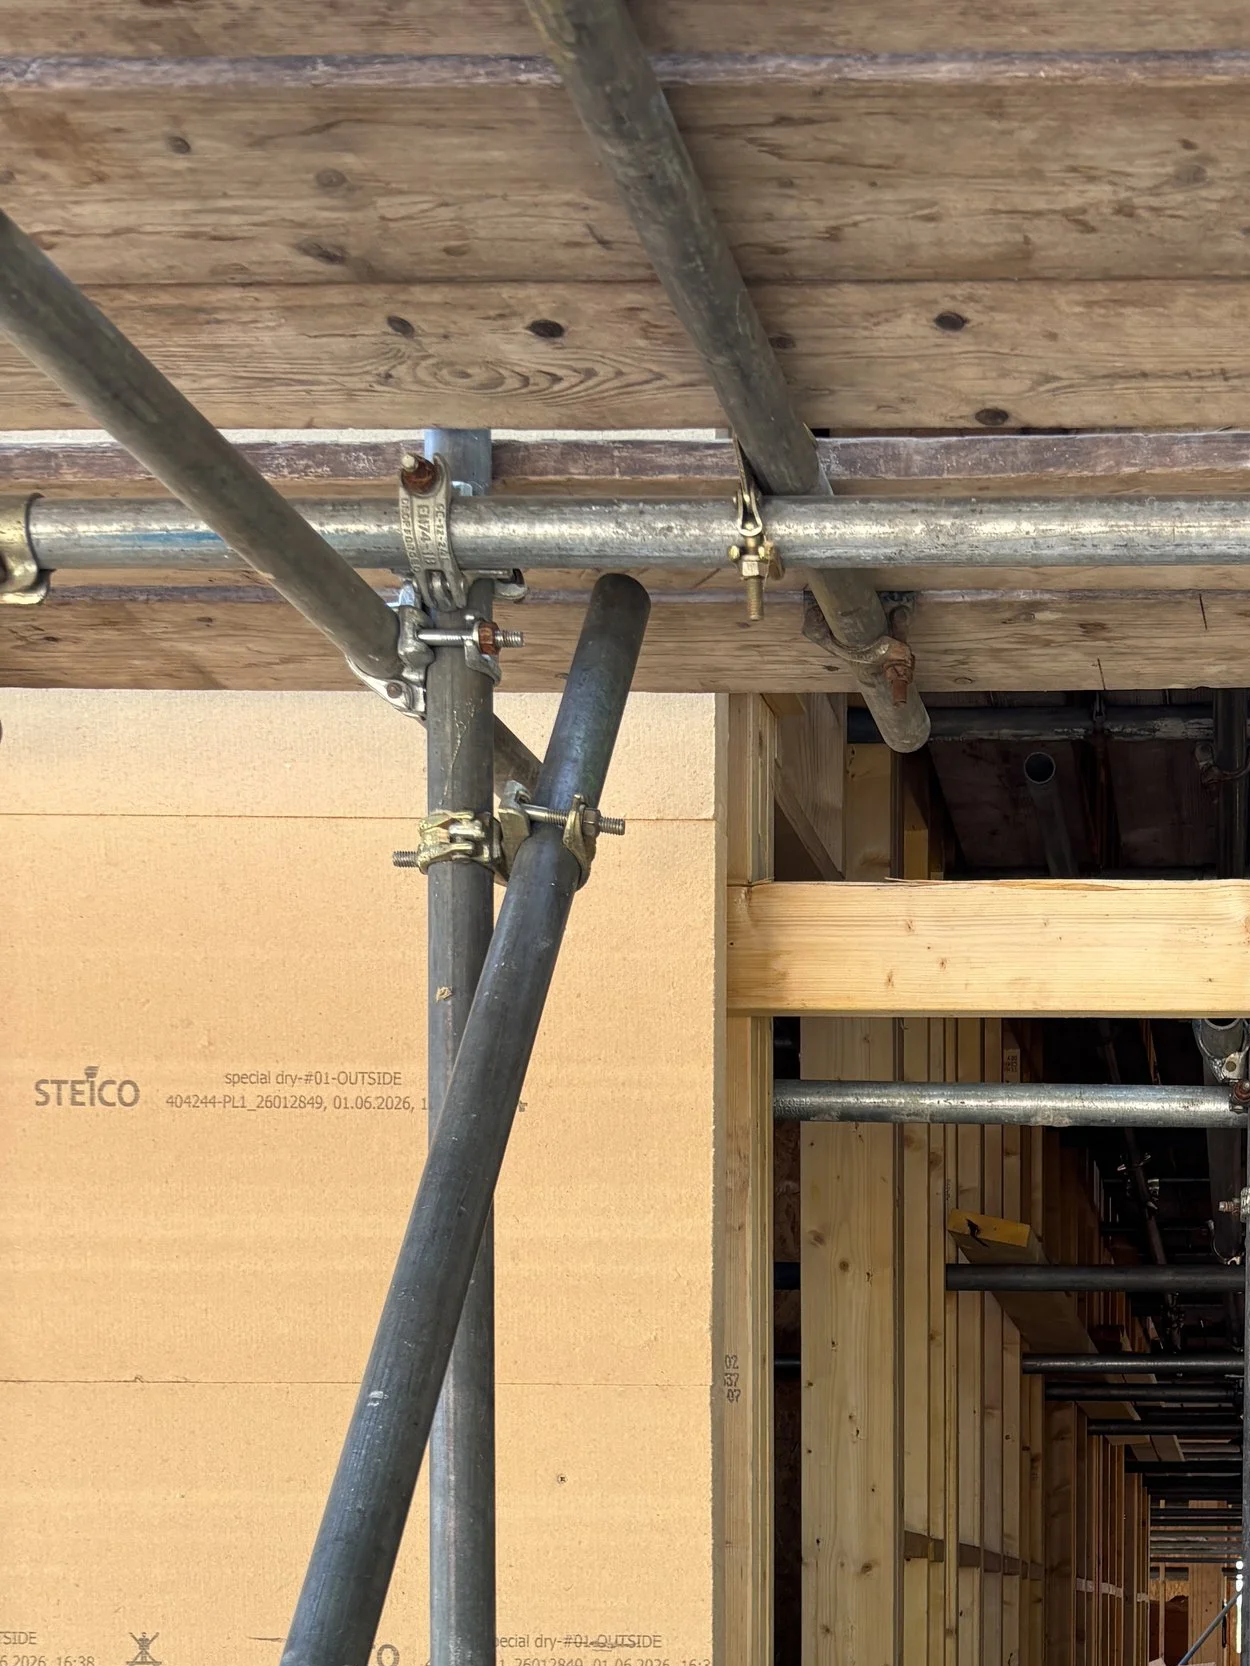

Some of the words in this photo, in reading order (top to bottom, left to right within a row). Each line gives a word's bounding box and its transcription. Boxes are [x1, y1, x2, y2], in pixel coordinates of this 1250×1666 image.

[34, 1066, 140, 1108] STEICO
[224, 1071, 270, 1087] special
[275, 1070, 402, 1088] dry-#01-OUTSIDE
[165, 1094, 327, 1112] 404244-PL1_26012849,
[333, 1095, 415, 1112] 01.06.2026,
[534, 1632, 662, 1653] dry-#01-OUTSIDE
